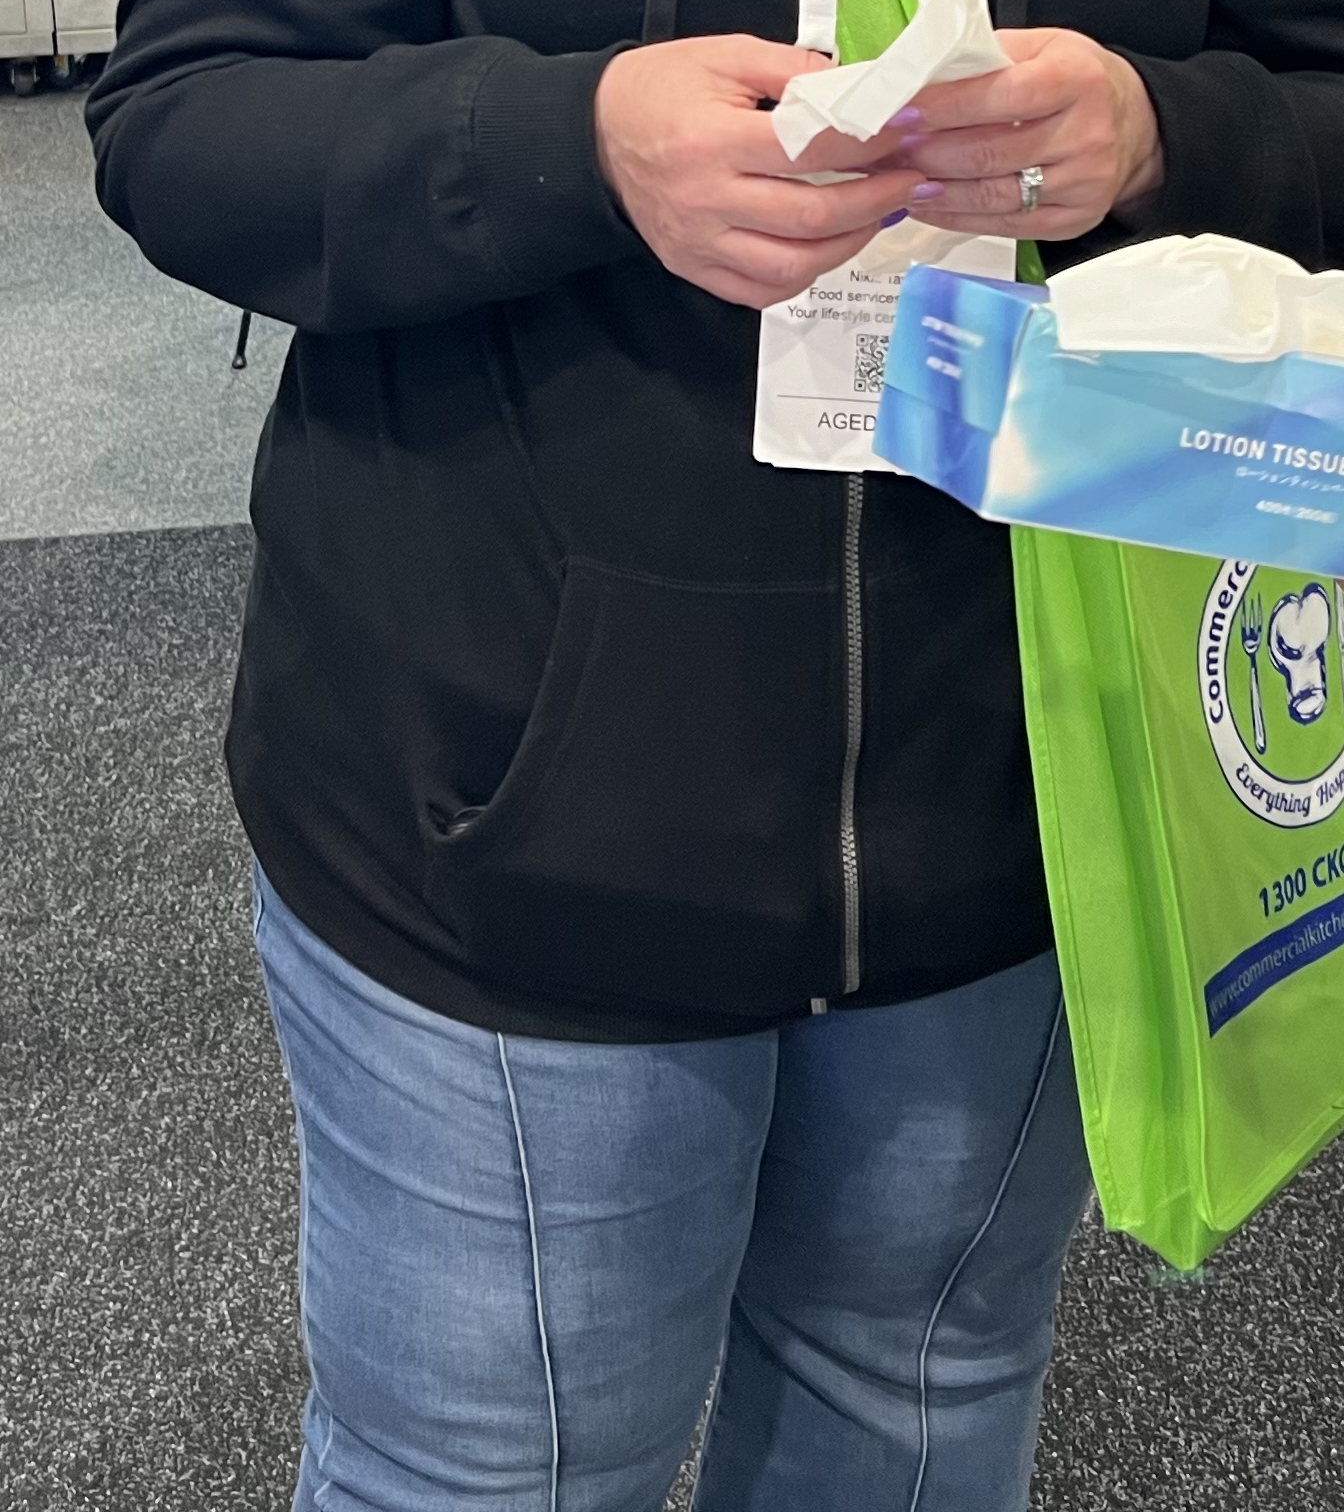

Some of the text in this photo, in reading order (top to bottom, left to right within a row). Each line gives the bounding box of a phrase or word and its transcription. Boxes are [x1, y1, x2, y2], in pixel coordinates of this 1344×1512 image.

[809, 287, 843, 302] Food
[787, 305, 818, 319] Your
[821, 306, 870, 325] lifestyle
[817, 412, 877, 432] AGED
[1179, 427, 1266, 461] LOTION
[1208, 560, 1250, 724] Commerc
[1235, 762, 1312, 818] Everything
[1259, 867, 1307, 918] 1300
